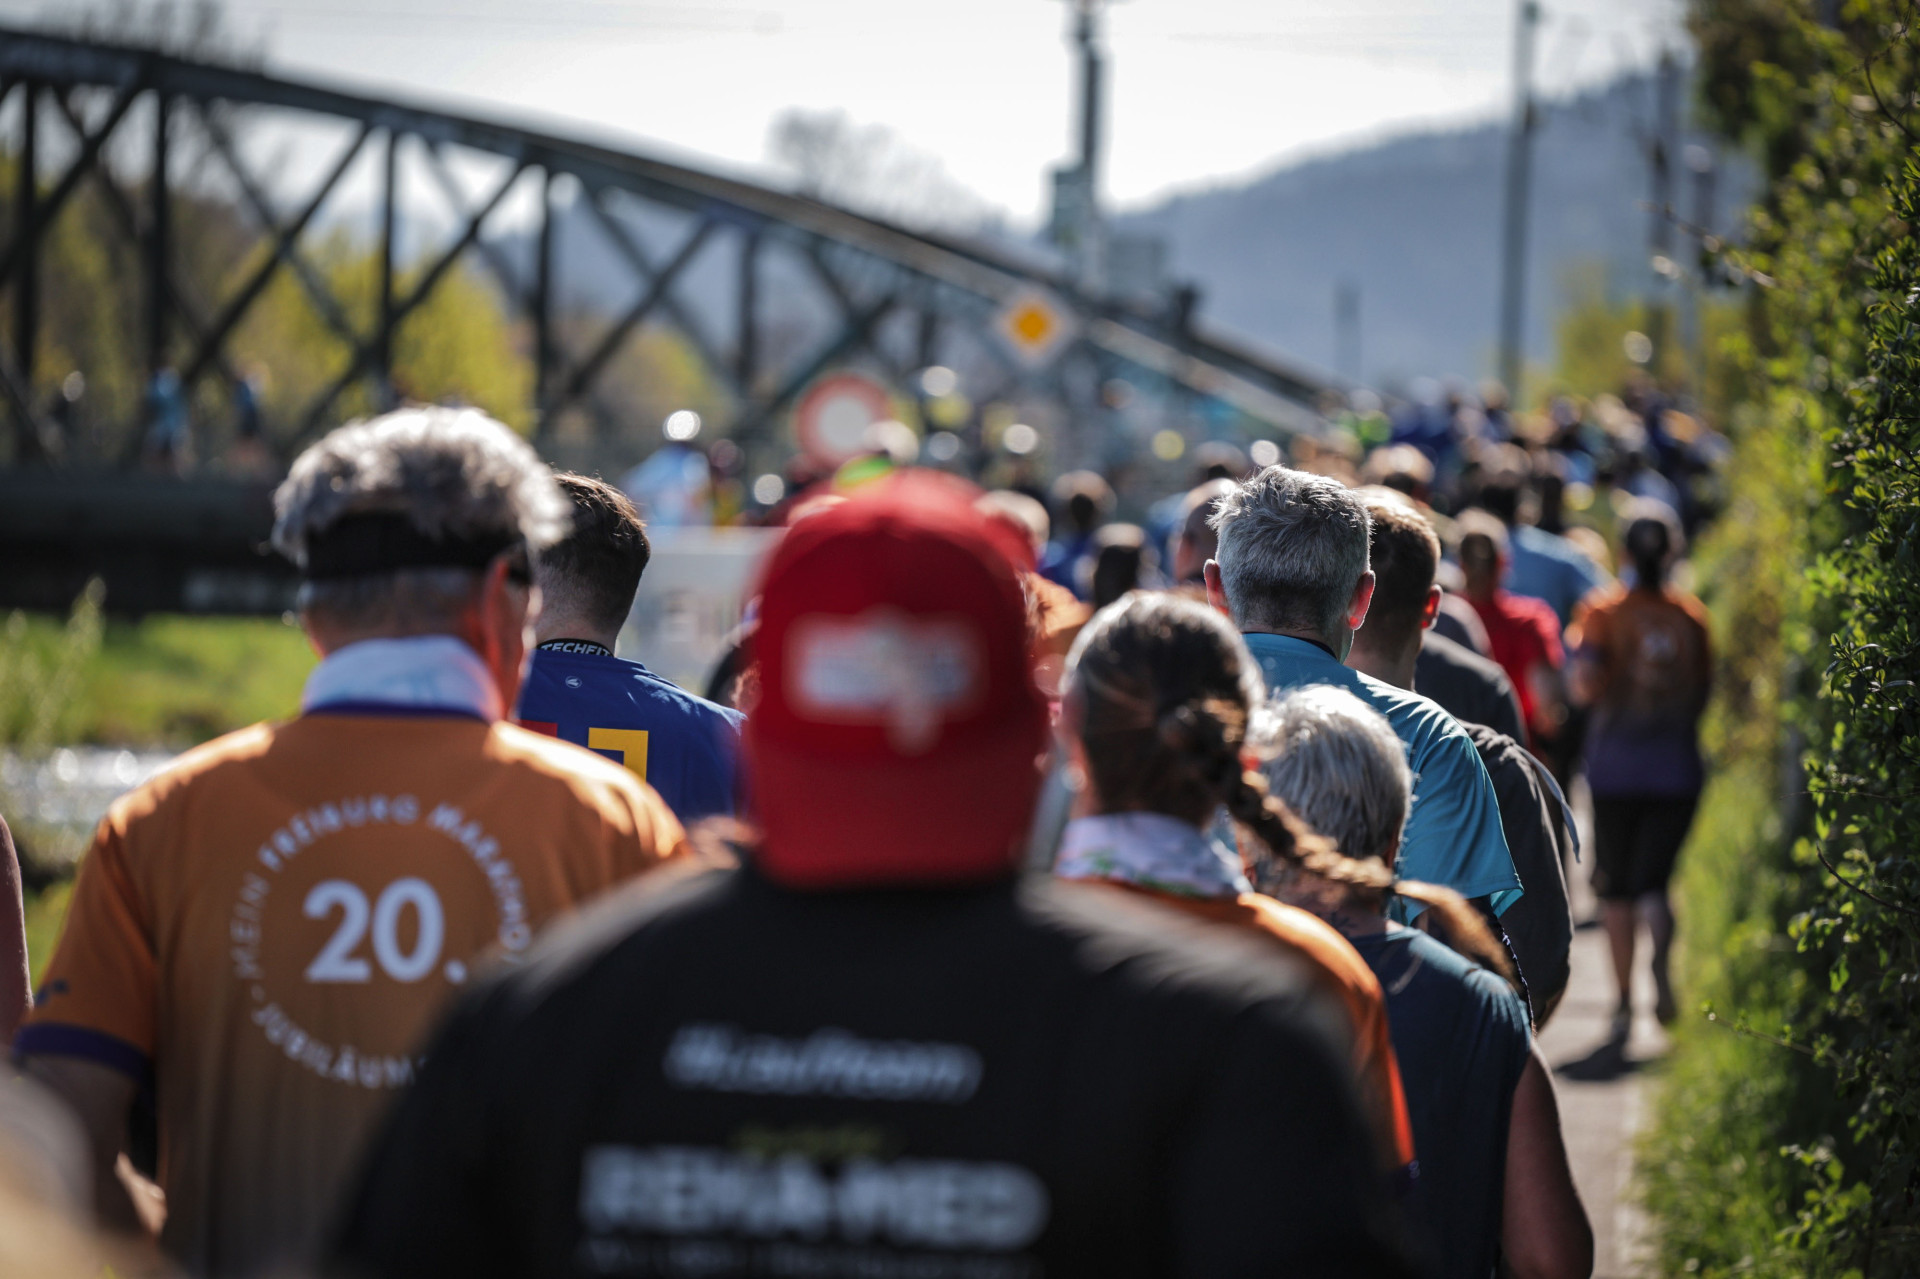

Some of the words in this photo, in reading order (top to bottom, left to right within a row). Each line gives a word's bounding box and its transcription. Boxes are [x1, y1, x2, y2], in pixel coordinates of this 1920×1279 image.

[541, 642, 611, 657] TECHFIT
[257, 793, 420, 872] FREIBURG
[425, 800, 533, 962] MARATHO
[303, 876, 467, 984] 20.
